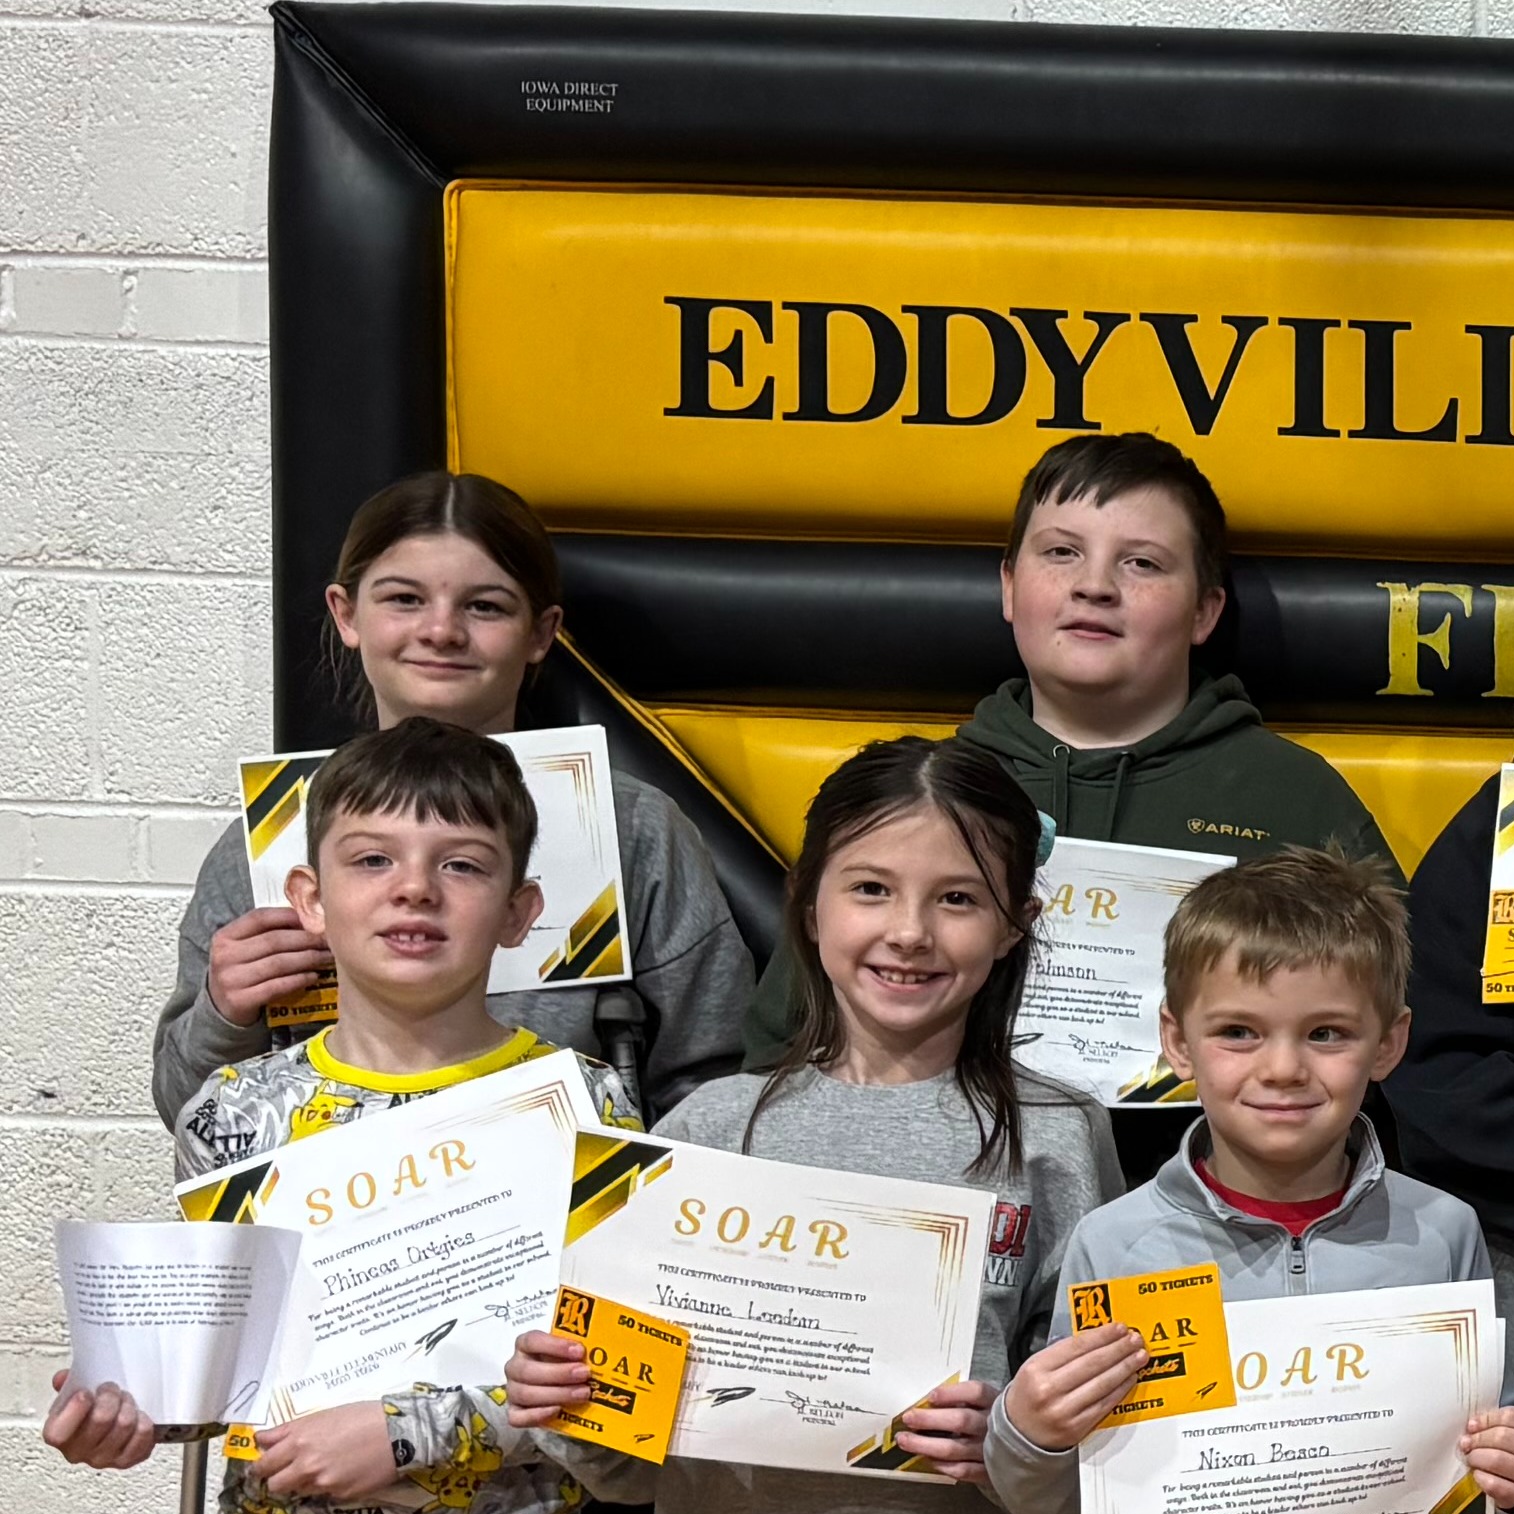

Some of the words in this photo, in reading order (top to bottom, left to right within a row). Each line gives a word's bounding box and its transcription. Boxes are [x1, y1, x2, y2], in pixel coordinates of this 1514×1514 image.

[521, 81, 560, 94] IOWA
[564, 82, 619, 96] DIRECT
[526, 98, 614, 112] EQUIPMENT
[1205, 823, 1265, 840] ARIAT
[1486, 982, 1502, 993] 50
[305, 1138, 476, 1227] SOAR
[674, 1197, 851, 1261] SOAR
[1138, 1281, 1157, 1294] 50
[1160, 1274, 1213, 1291] TICKETS
[618, 1315, 635, 1328] 50
[589, 1347, 655, 1385] OAR
[1236, 1342, 1370, 1391] OAR
[228, 1434, 251, 1448] 50
[1199, 1447, 1255, 1470] Nixon
